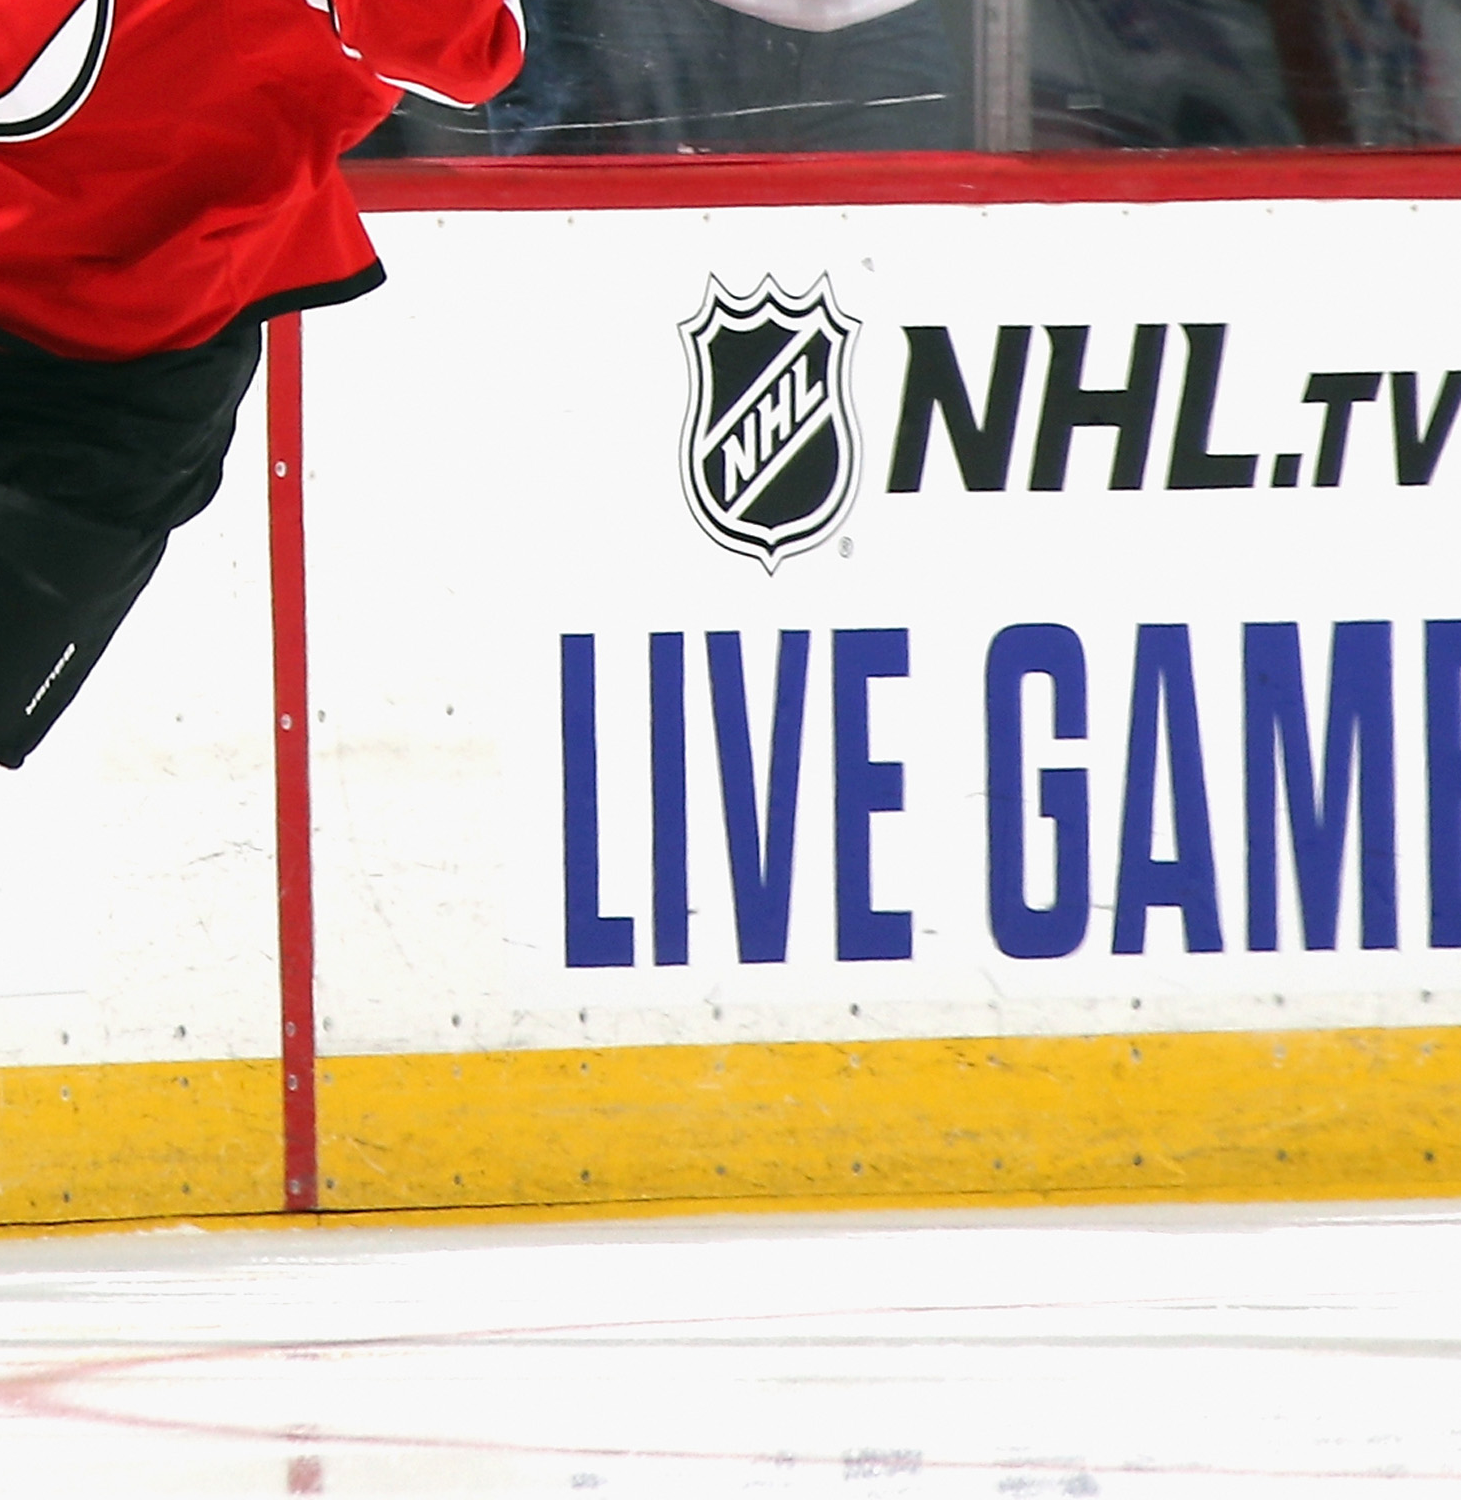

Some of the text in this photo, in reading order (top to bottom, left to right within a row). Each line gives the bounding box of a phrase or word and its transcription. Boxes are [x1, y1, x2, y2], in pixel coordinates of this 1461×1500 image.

[721, 353, 824, 503] NHL
[885, 323, 1461, 493] NHL.TV
[559, 627, 913, 968] LIVE
